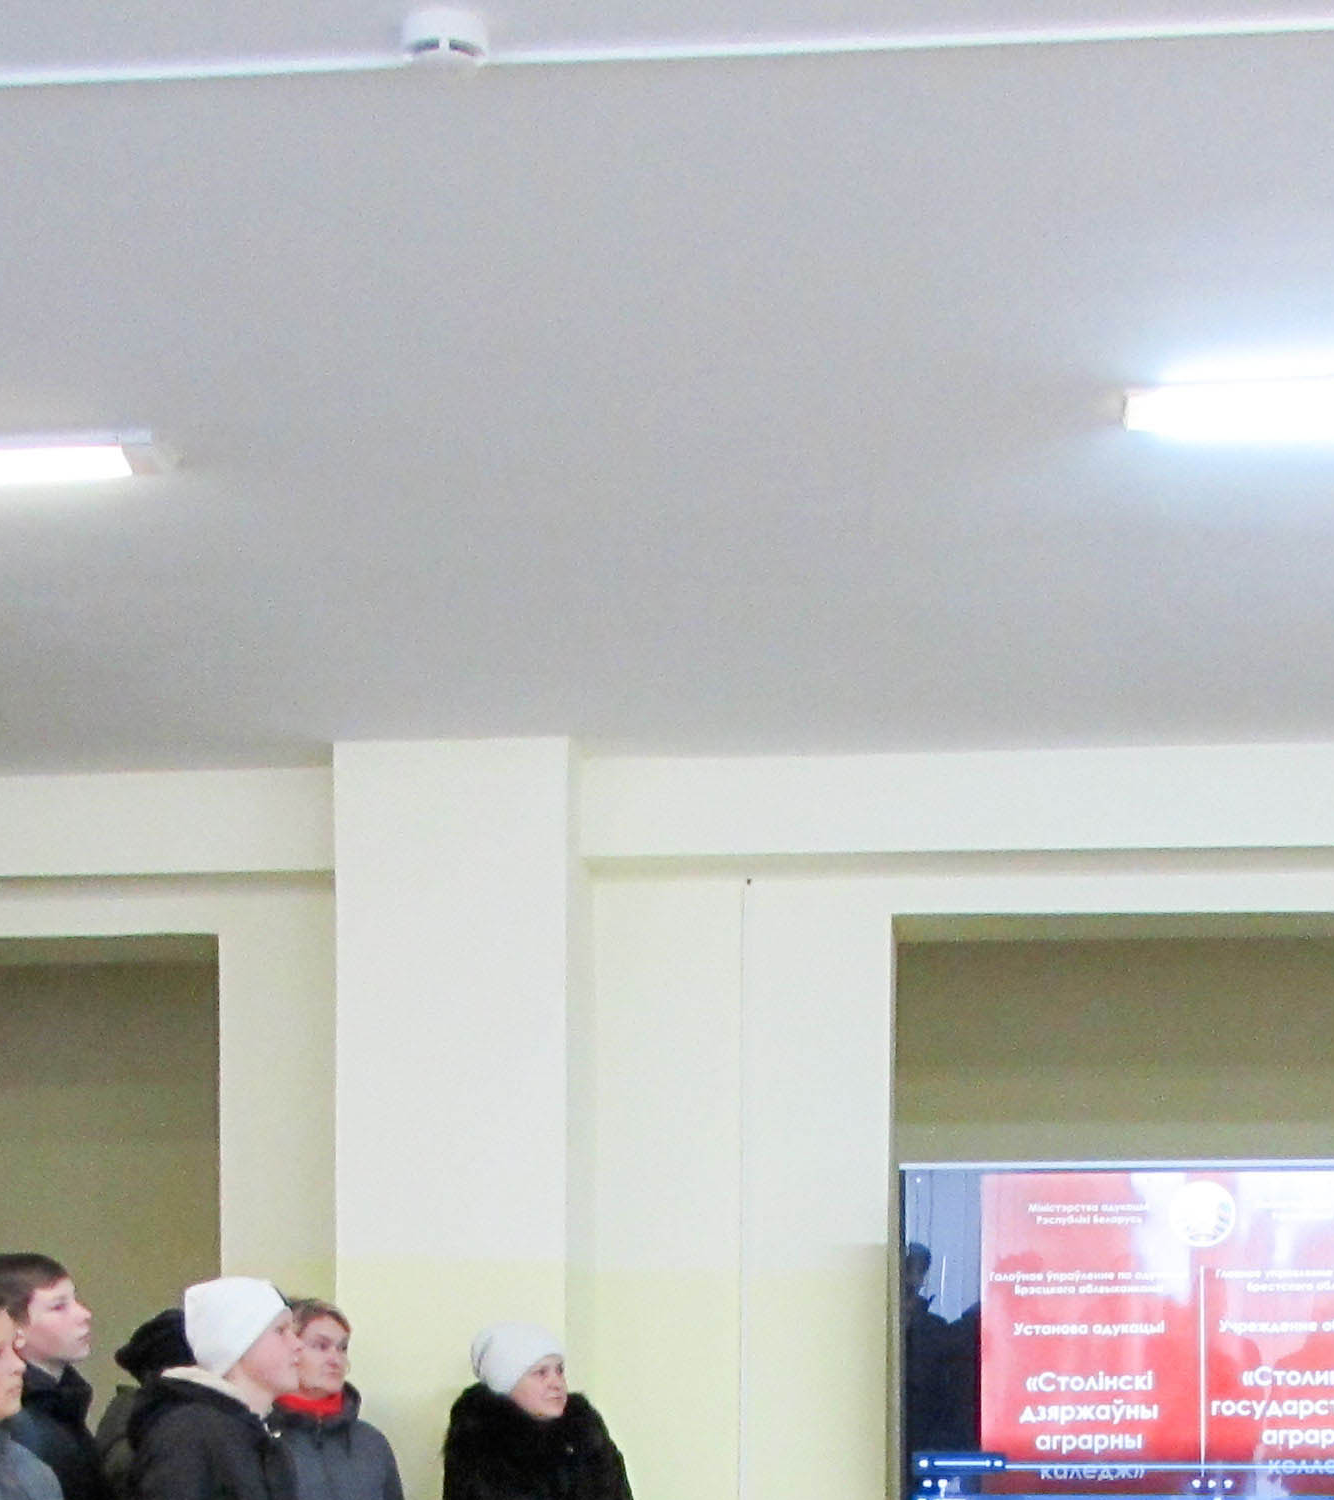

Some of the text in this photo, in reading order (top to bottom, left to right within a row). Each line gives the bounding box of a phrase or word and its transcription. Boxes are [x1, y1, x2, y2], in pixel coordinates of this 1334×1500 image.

[1013, 1320, 1165, 1337] Установа адукацыі
[1219, 1319, 1317, 1336] Учреждение
[1025, 1371, 1154, 1392] «Столінскі
[1019, 1399, 1159, 1424] дзяржаўны
[1035, 1433, 1143, 1454] аграрны
